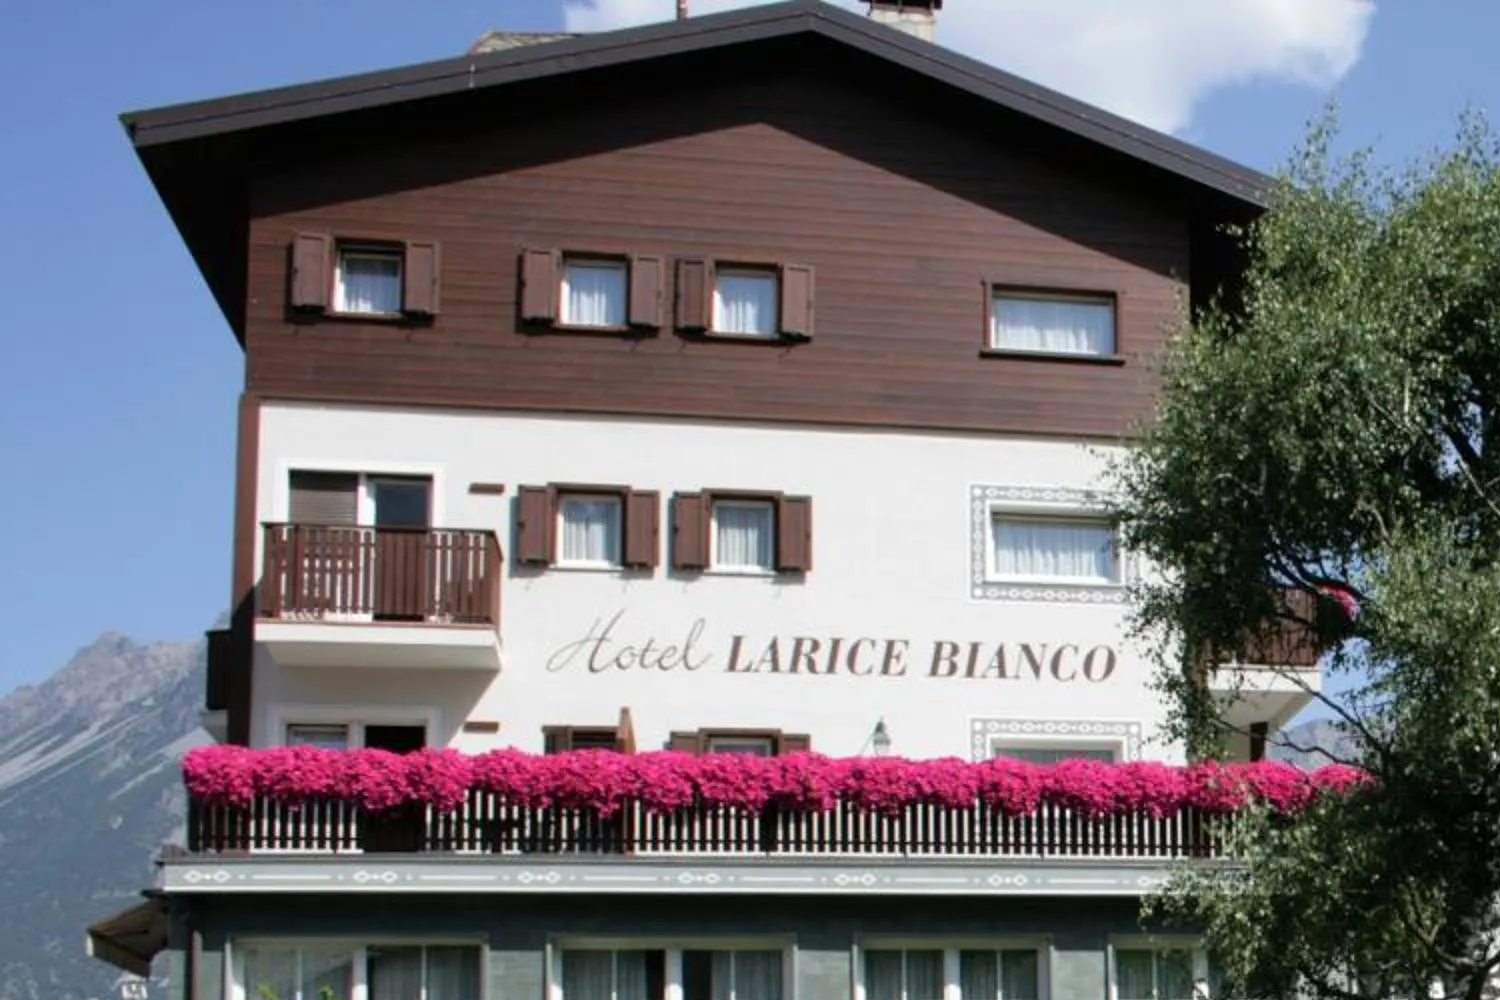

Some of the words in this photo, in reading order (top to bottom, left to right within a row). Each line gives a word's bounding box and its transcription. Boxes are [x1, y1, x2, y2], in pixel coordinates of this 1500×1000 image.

[545, 607, 711, 673] Hotel
[724, 635, 911, 677] LARICE
[928, 640, 1118, 684] BIANCO
